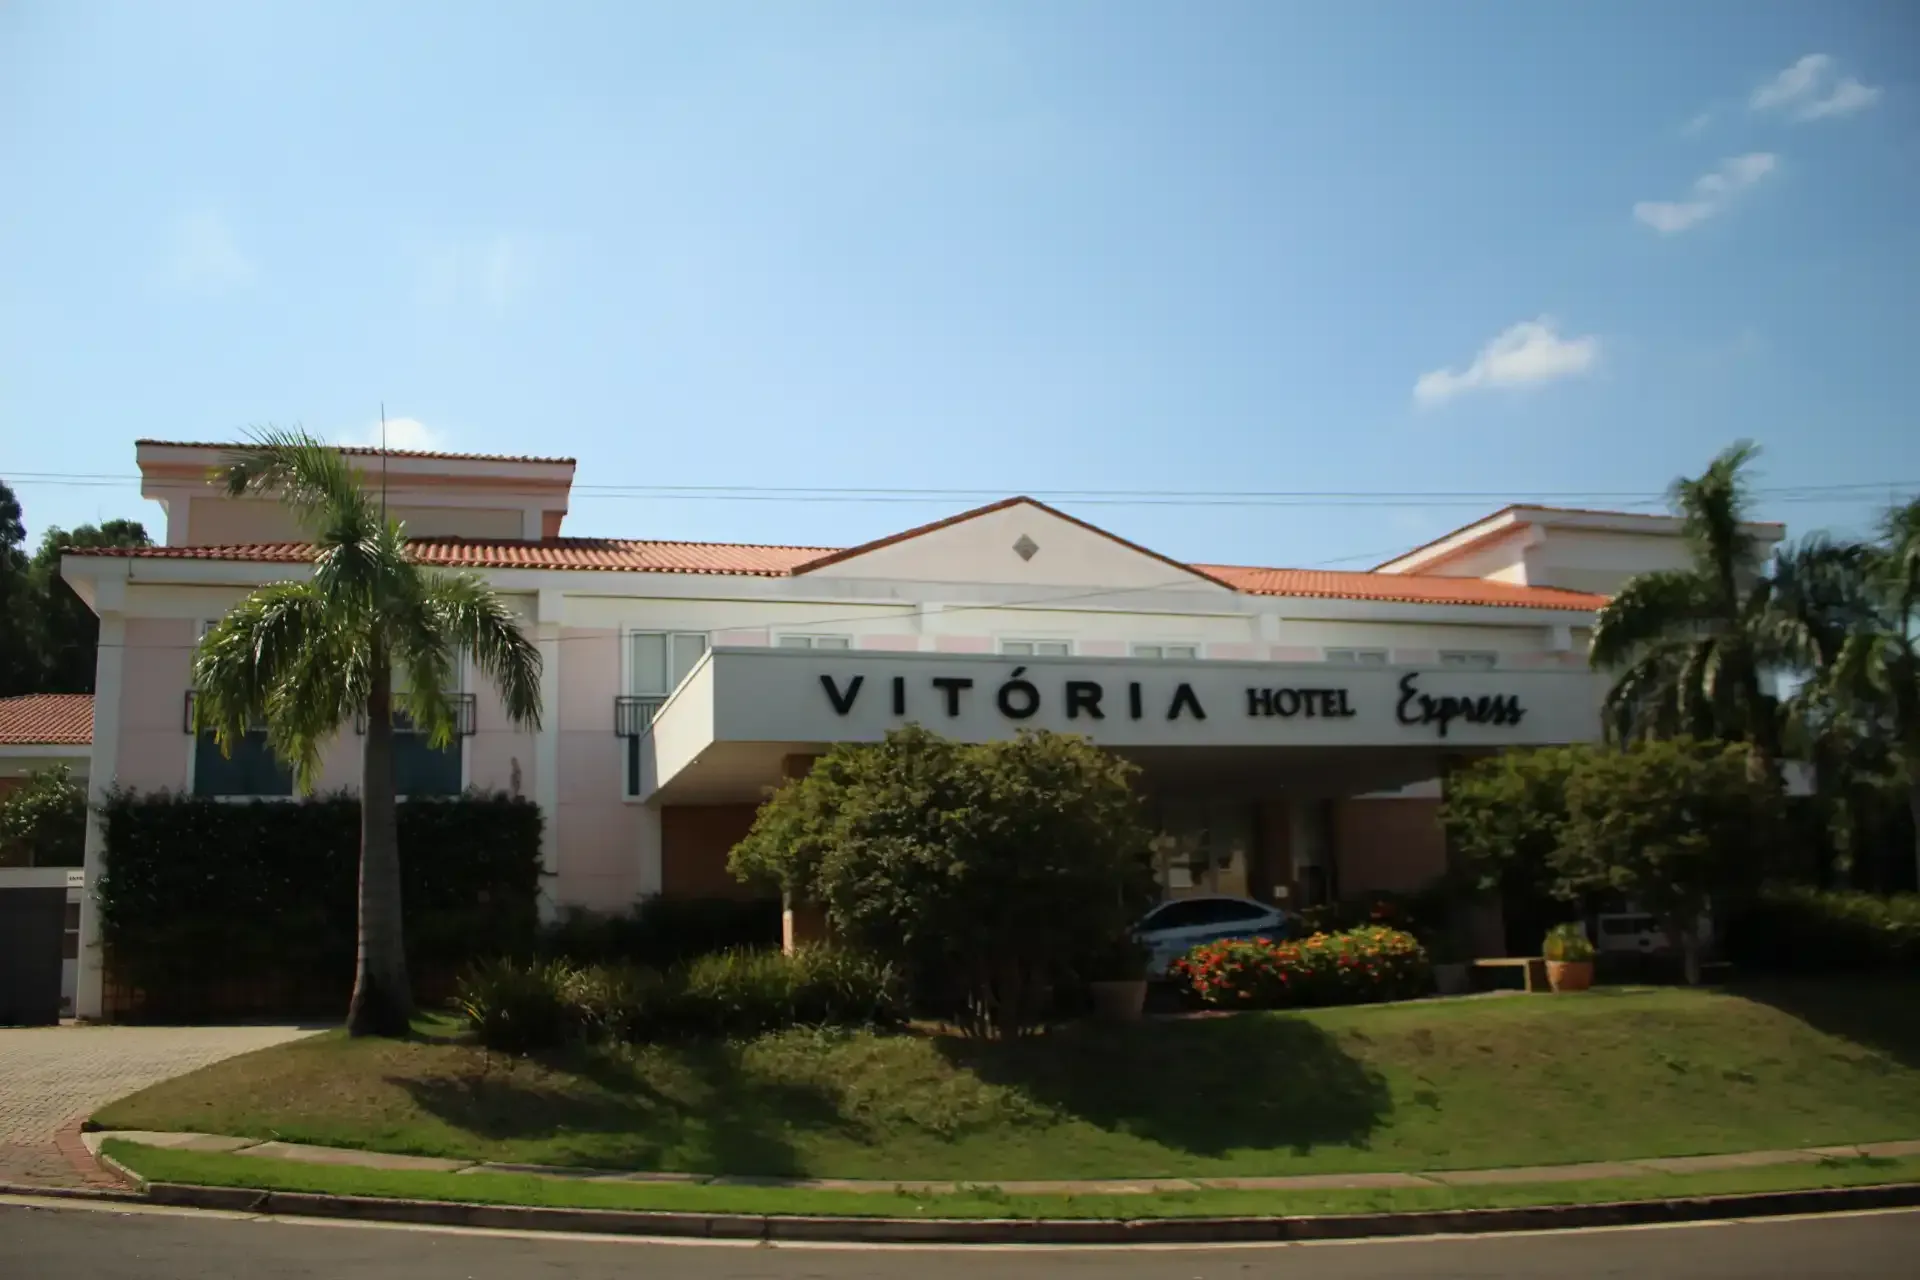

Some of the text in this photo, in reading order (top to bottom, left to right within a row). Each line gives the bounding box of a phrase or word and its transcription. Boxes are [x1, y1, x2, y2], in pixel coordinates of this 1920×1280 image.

[820, 666, 1527, 737] VITÓRIA HOTEL Express
